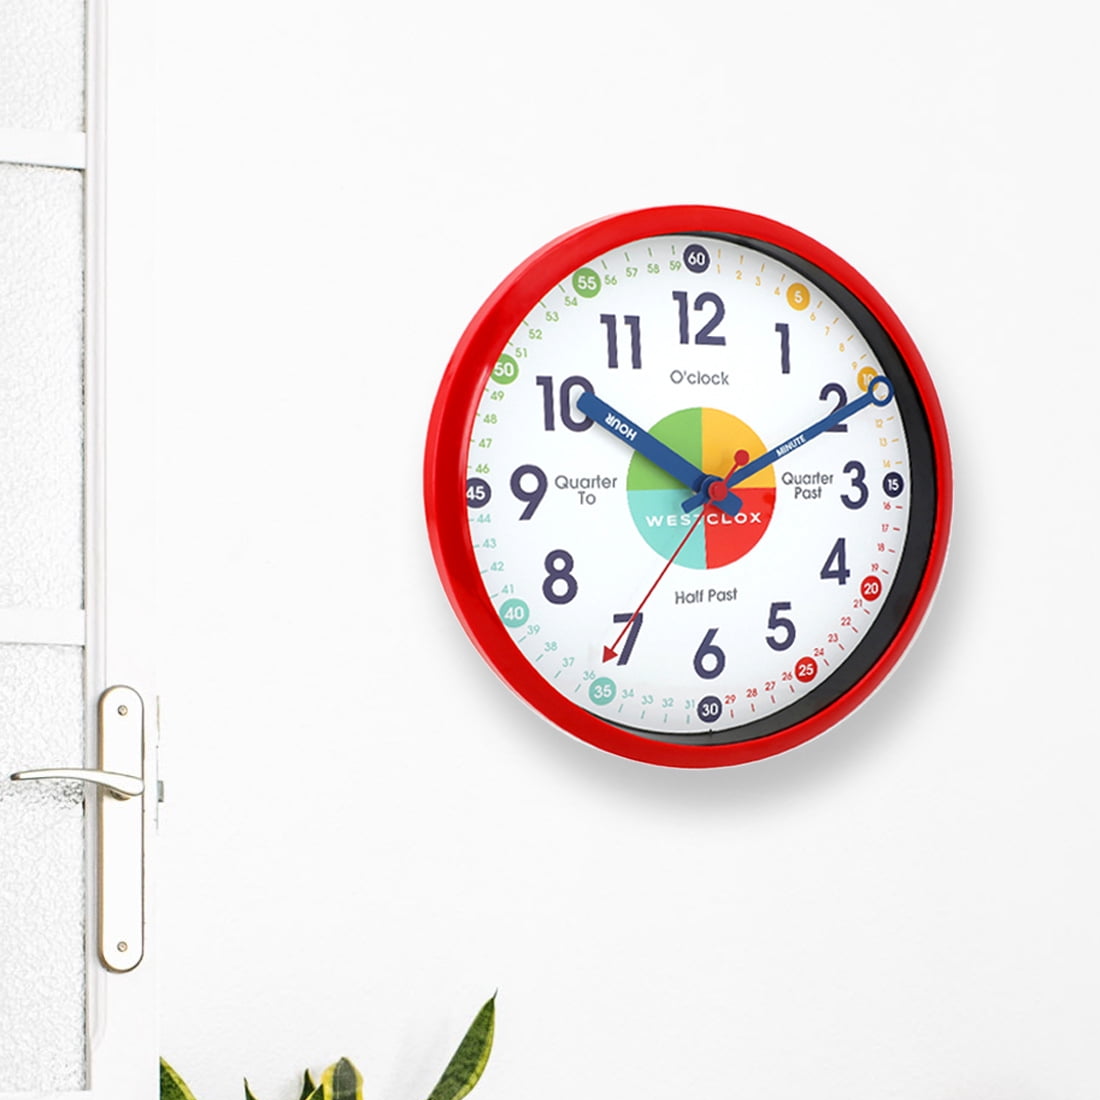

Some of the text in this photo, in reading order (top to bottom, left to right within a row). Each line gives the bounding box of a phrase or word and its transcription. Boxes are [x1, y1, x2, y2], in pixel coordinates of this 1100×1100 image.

[688, 251, 705, 265] 60
[647, 263, 660, 274] 58
[669, 260, 681, 271] 59
[626, 267, 638, 278] 57
[577, 275, 597, 290] 55
[605, 275, 618, 286] 56
[564, 296, 578, 307] 54
[794, 291, 803, 303] 5
[545, 311, 559, 322] 53
[672, 290, 726, 346] 12
[529, 329, 542, 340] 52
[600, 313, 642, 370] 11
[515, 348, 528, 358] 51
[775, 322, 790, 374] 1
[494, 363, 513, 376] 50
[670, 370, 729, 385] O'clock
[490, 391, 505, 401] 49
[536, 375, 595, 432] 10
[819, 382, 848, 433] 2
[483, 414, 497, 425] 48
[605, 412, 638, 441] HOUR
[479, 438, 493, 449] 47
[776, 434, 806, 457] MINUTE
[475, 463, 490, 474] 46
[554, 475, 617, 490] Quarter
[782, 472, 834, 487] Quarter
[840, 460, 869, 510] 3
[888, 479, 899, 491] 15
[466, 486, 485, 500] 45
[510, 464, 548, 521] 9
[578, 491, 596, 505] To
[795, 486, 822, 499] Past
[883, 502, 891, 511] 16
[476, 514, 491, 523] 44
[881, 524, 889, 533] 17
[482, 538, 497, 549] 43
[877, 543, 885, 552] 18
[490, 562, 504, 572] 42
[820, 538, 850, 585] 4
[871, 563, 879, 572] 19
[542, 549, 578, 605] 8
[501, 584, 514, 594] 41
[864, 583, 879, 595] 20
[675, 588, 738, 604] Half Past
[853, 599, 863, 609] 21
[504, 606, 524, 620] 40
[766, 602, 796, 652] 5
[841, 617, 851, 626] 22
[527, 625, 541, 635] 39
[613, 612, 643, 666] 7
[828, 633, 838, 643] 23
[544, 642, 558, 653] 38
[814, 647, 824, 657] 24
[693, 628, 726, 680] 6
[562, 657, 575, 667] 37
[799, 663, 814, 675] 25
[583, 670, 596, 681] 36
[782, 671, 792, 681] 26
[594, 685, 612, 698] 35
[765, 681, 776, 691] 27
[622, 689, 635, 699] 34
[746, 688, 758, 698] 28
[641, 695, 653, 705] 33
[662, 698, 674, 708] 32
[685, 700, 696, 709] 31
[725, 695, 736, 704] 29
[703, 703, 719, 716] 30
